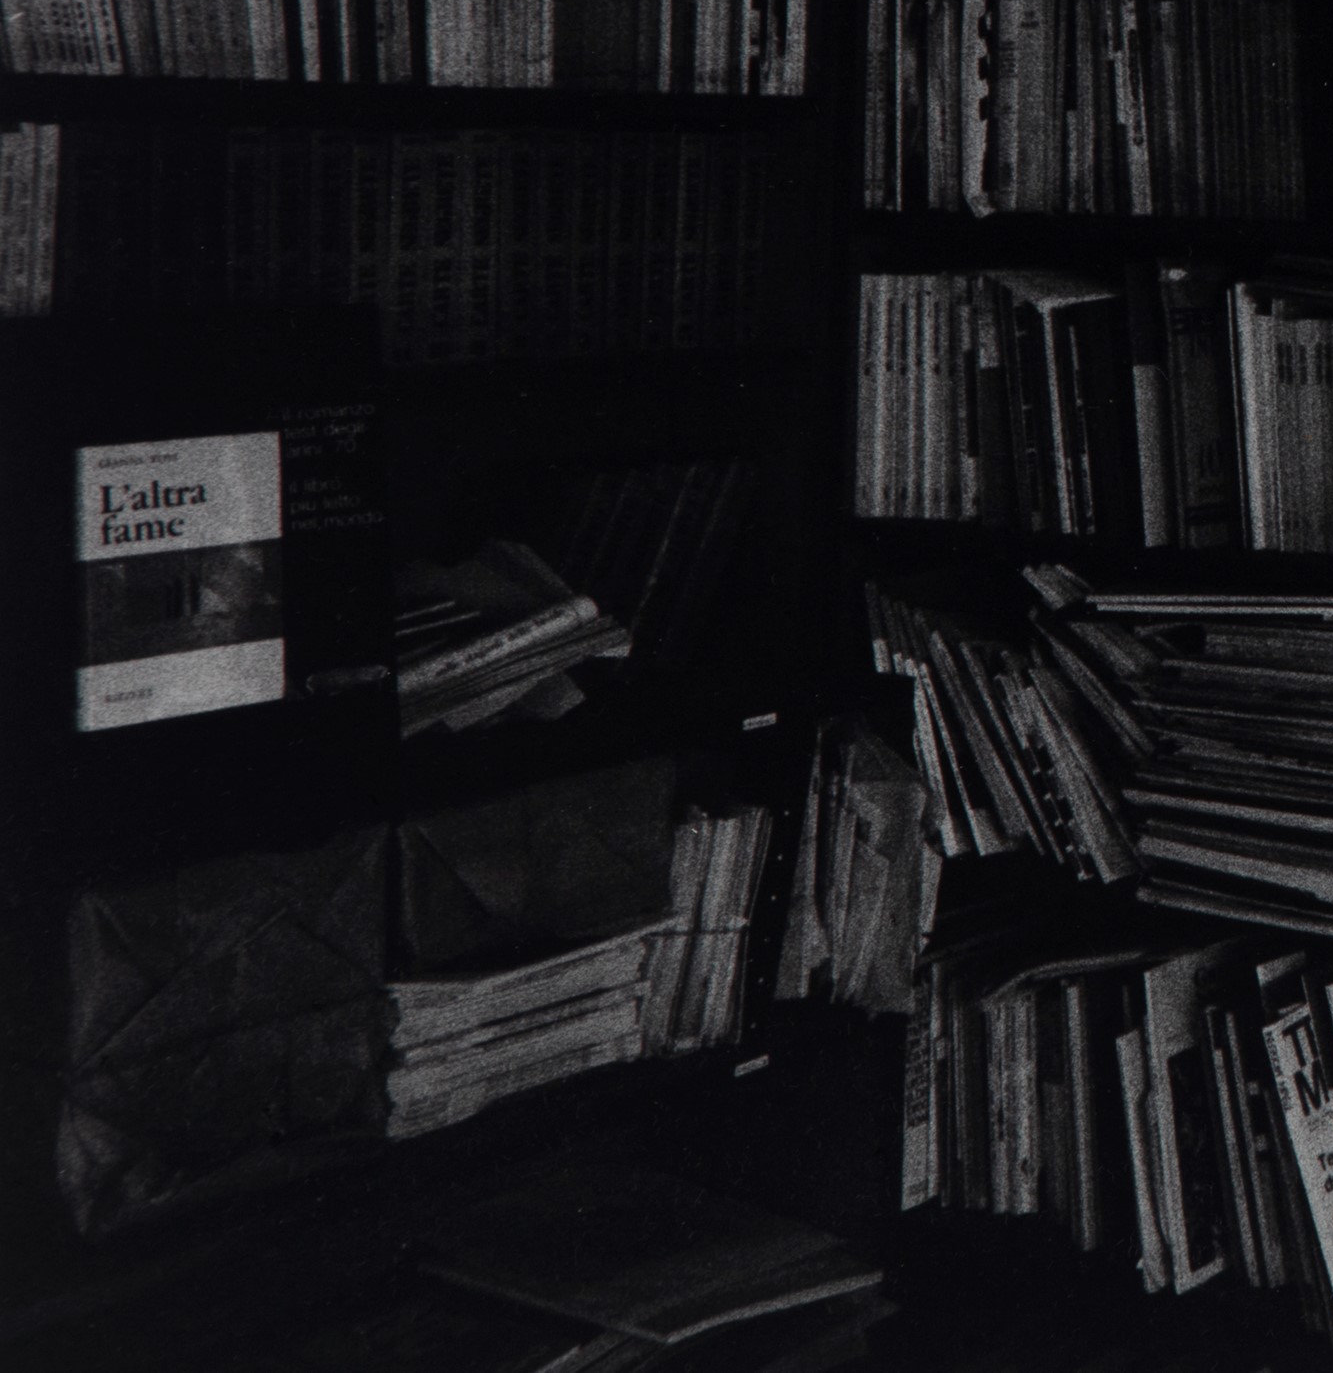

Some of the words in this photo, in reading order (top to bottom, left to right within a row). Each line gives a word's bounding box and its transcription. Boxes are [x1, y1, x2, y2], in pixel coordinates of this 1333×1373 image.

[296, 403, 376, 420] romanzo
[303, 475, 343, 492] libro
[99, 479, 208, 515] L'altra
[323, 510, 386, 526] mondo
[101, 513, 186, 546] fame
